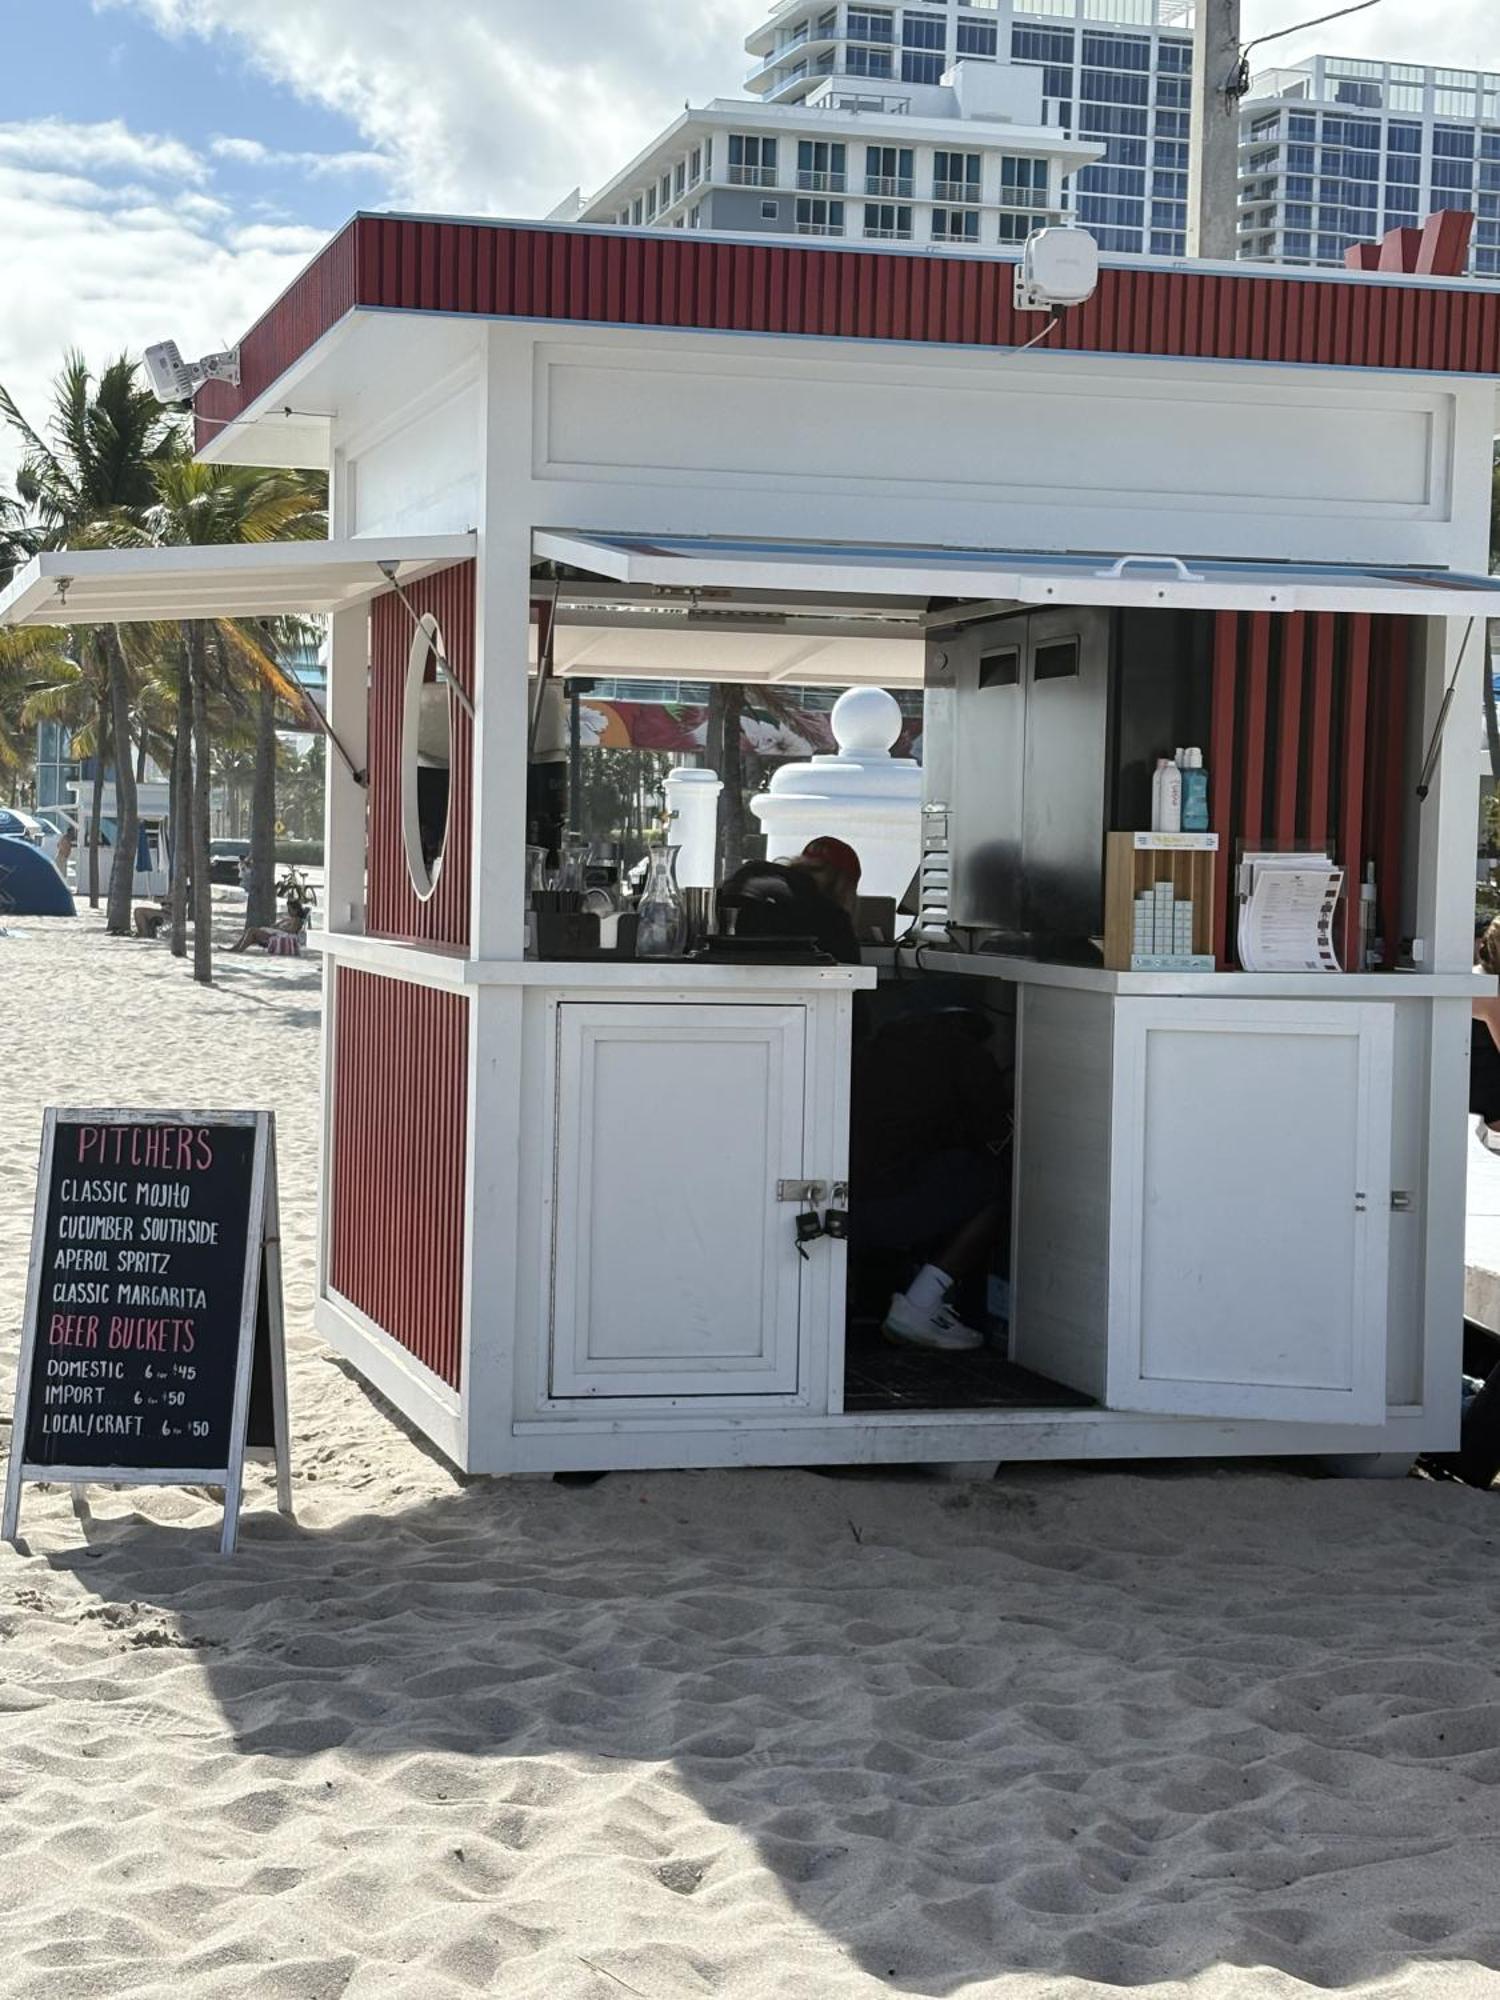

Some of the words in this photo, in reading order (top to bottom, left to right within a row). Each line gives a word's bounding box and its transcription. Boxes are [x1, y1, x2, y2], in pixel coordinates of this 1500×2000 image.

[78, 1127, 213, 1171] PITCHERS
[61, 1179, 127, 1203] CLASSIC
[59, 1216, 133, 1241] CUCUMBER
[140, 1217, 219, 1244] SOUTHSIDE
[54, 1249, 110, 1272] APEROL
[117, 1250, 171, 1275] SPRITZ
[53, 1283, 109, 1304] CLASSIC
[117, 1284, 207, 1309] MARGARITA
[50, 1313, 99, 1349] BEER
[109, 1316, 195, 1352] BUCKETS
[47, 1359, 124, 1379] DOMESTIC
[145, 1364, 153, 1379] 6
[45, 1385, 105, 1405] IMPORT
[134, 1391, 143, 1405] 6
[42, 1413, 144, 1436] LOCAL/CRAFT
[162, 1419, 171, 1436] 6
